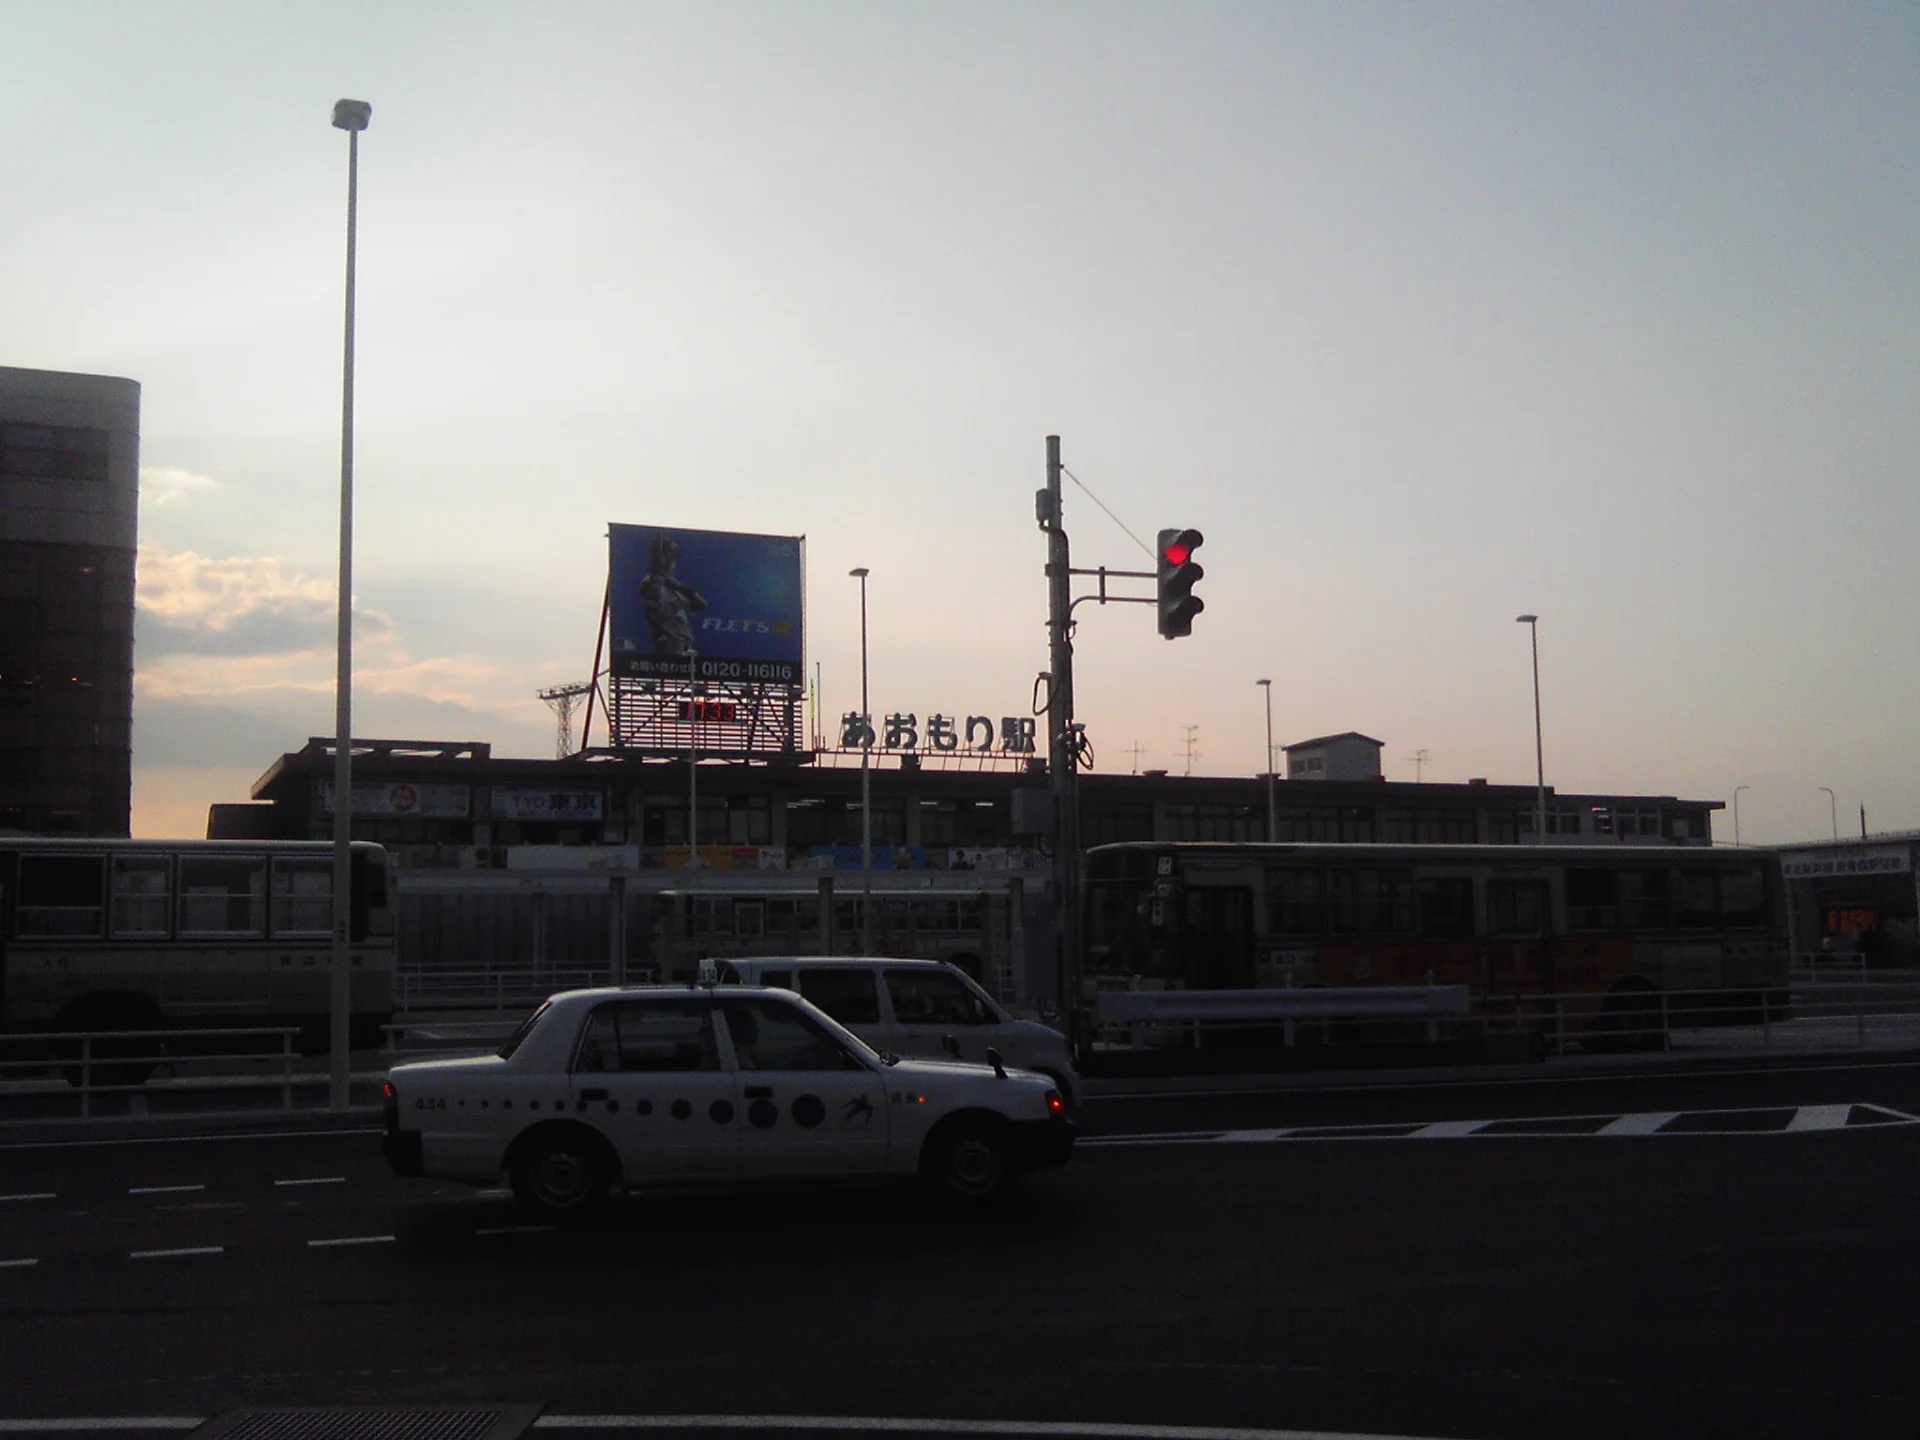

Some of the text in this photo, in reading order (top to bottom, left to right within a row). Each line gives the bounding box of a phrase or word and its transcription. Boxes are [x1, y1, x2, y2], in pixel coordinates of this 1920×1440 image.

[701, 660, 793, 680] 0120-116116
[841, 710, 1037, 753] あおもり駅
